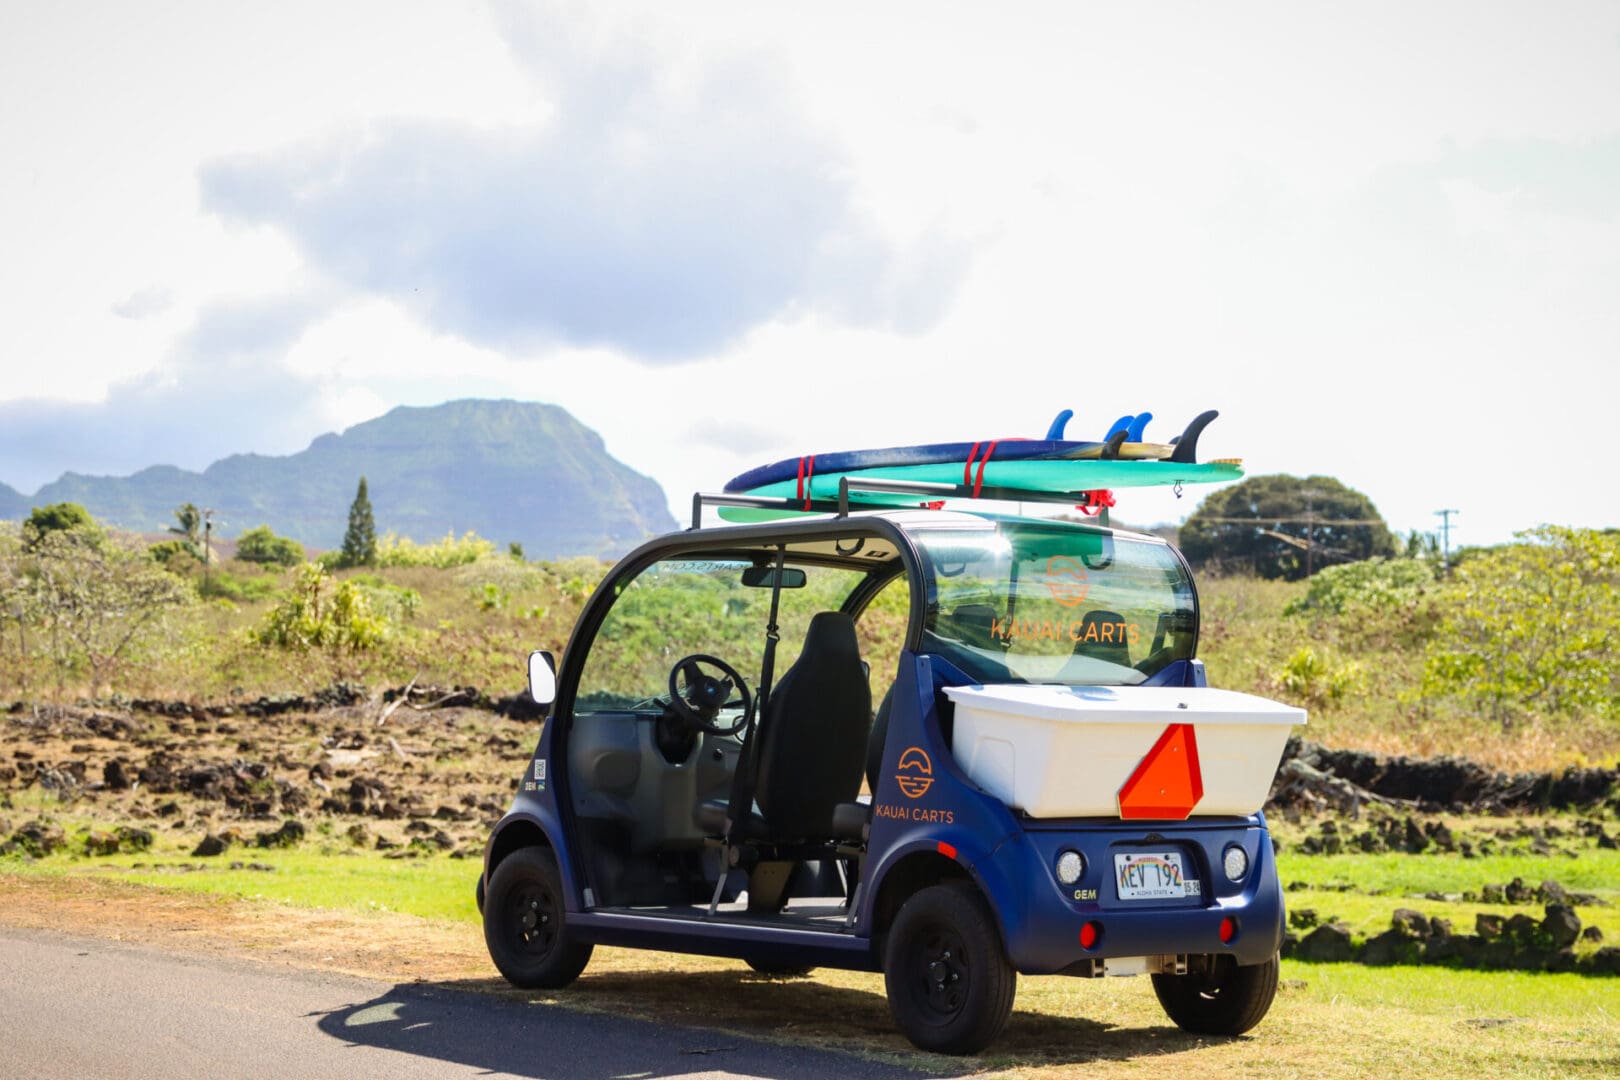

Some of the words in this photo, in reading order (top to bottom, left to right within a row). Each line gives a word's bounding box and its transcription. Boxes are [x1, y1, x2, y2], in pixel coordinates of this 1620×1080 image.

[991, 618, 1061, 640] KAUAI
[1069, 620, 1140, 644] CARTS
[876, 805, 909, 820] KAUAI
[912, 808, 954, 824] CARTS
[1119, 864, 1145, 888] KEV
[1155, 863, 1182, 887] 192
[1074, 889, 1097, 900] GEM
